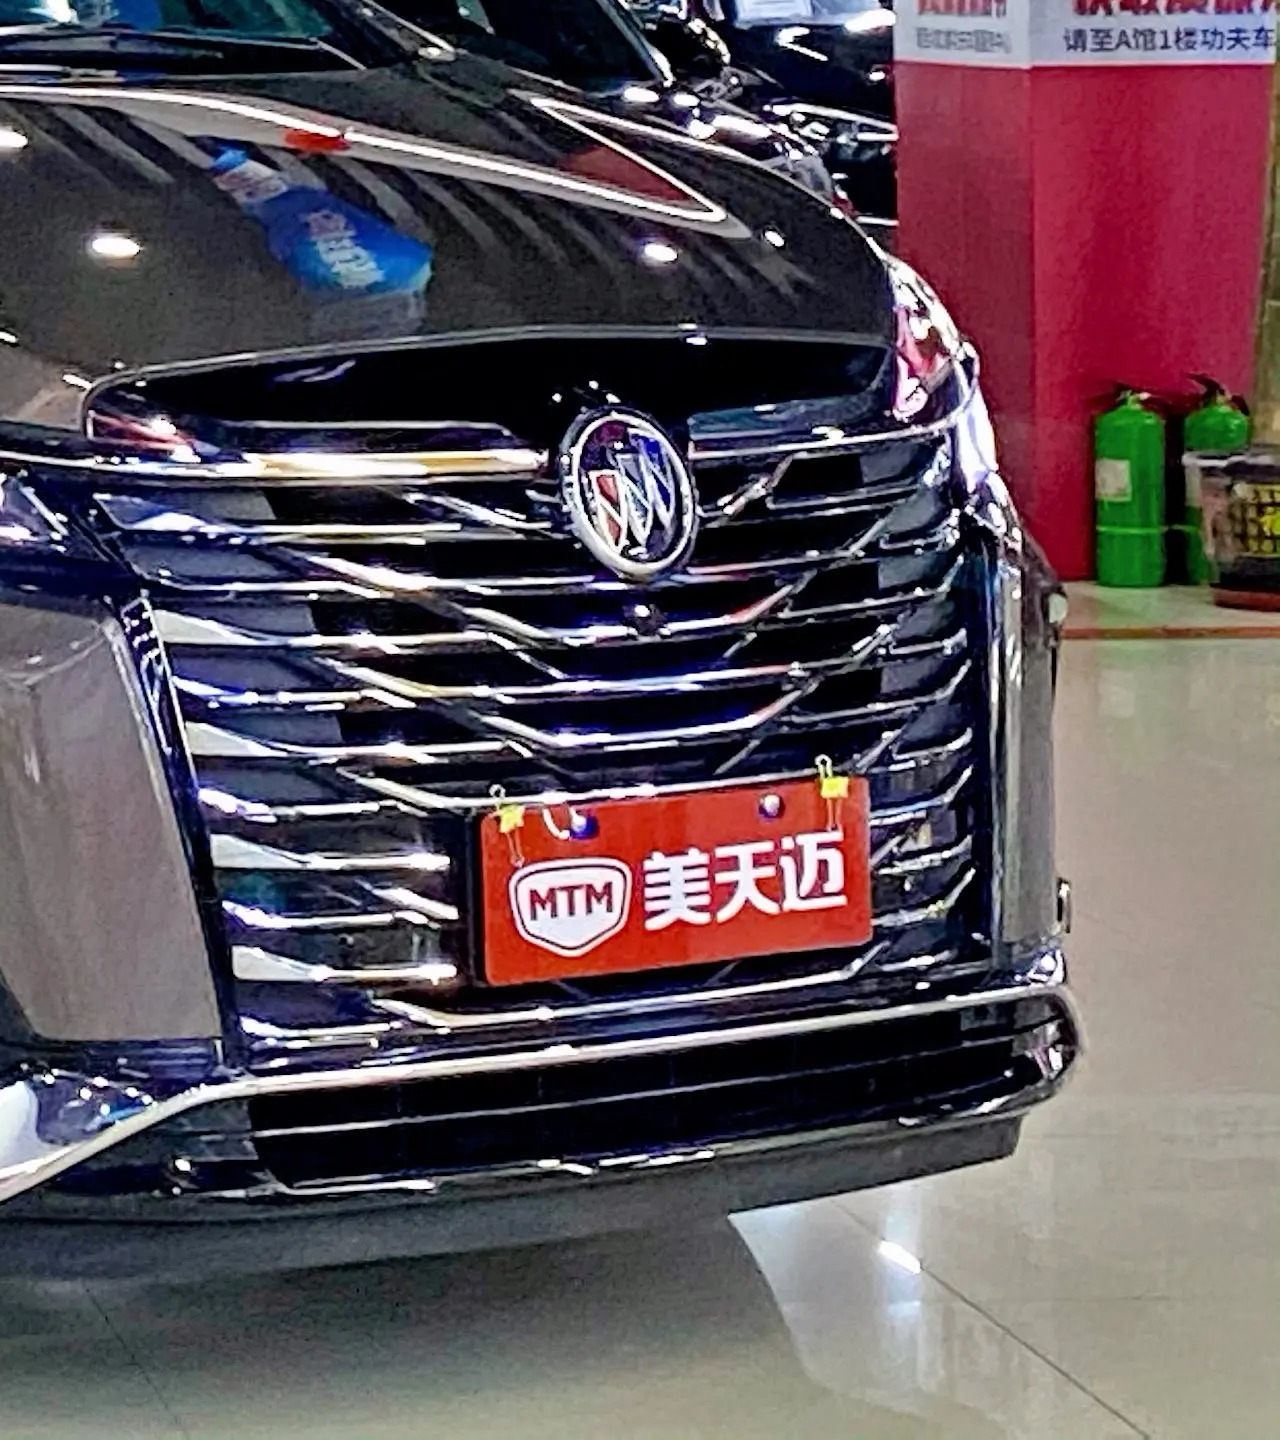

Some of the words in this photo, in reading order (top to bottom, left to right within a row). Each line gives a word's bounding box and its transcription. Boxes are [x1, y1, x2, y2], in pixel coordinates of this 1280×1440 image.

[529, 880, 615, 922] MTM
[643, 831, 848, 931] 美天迈
